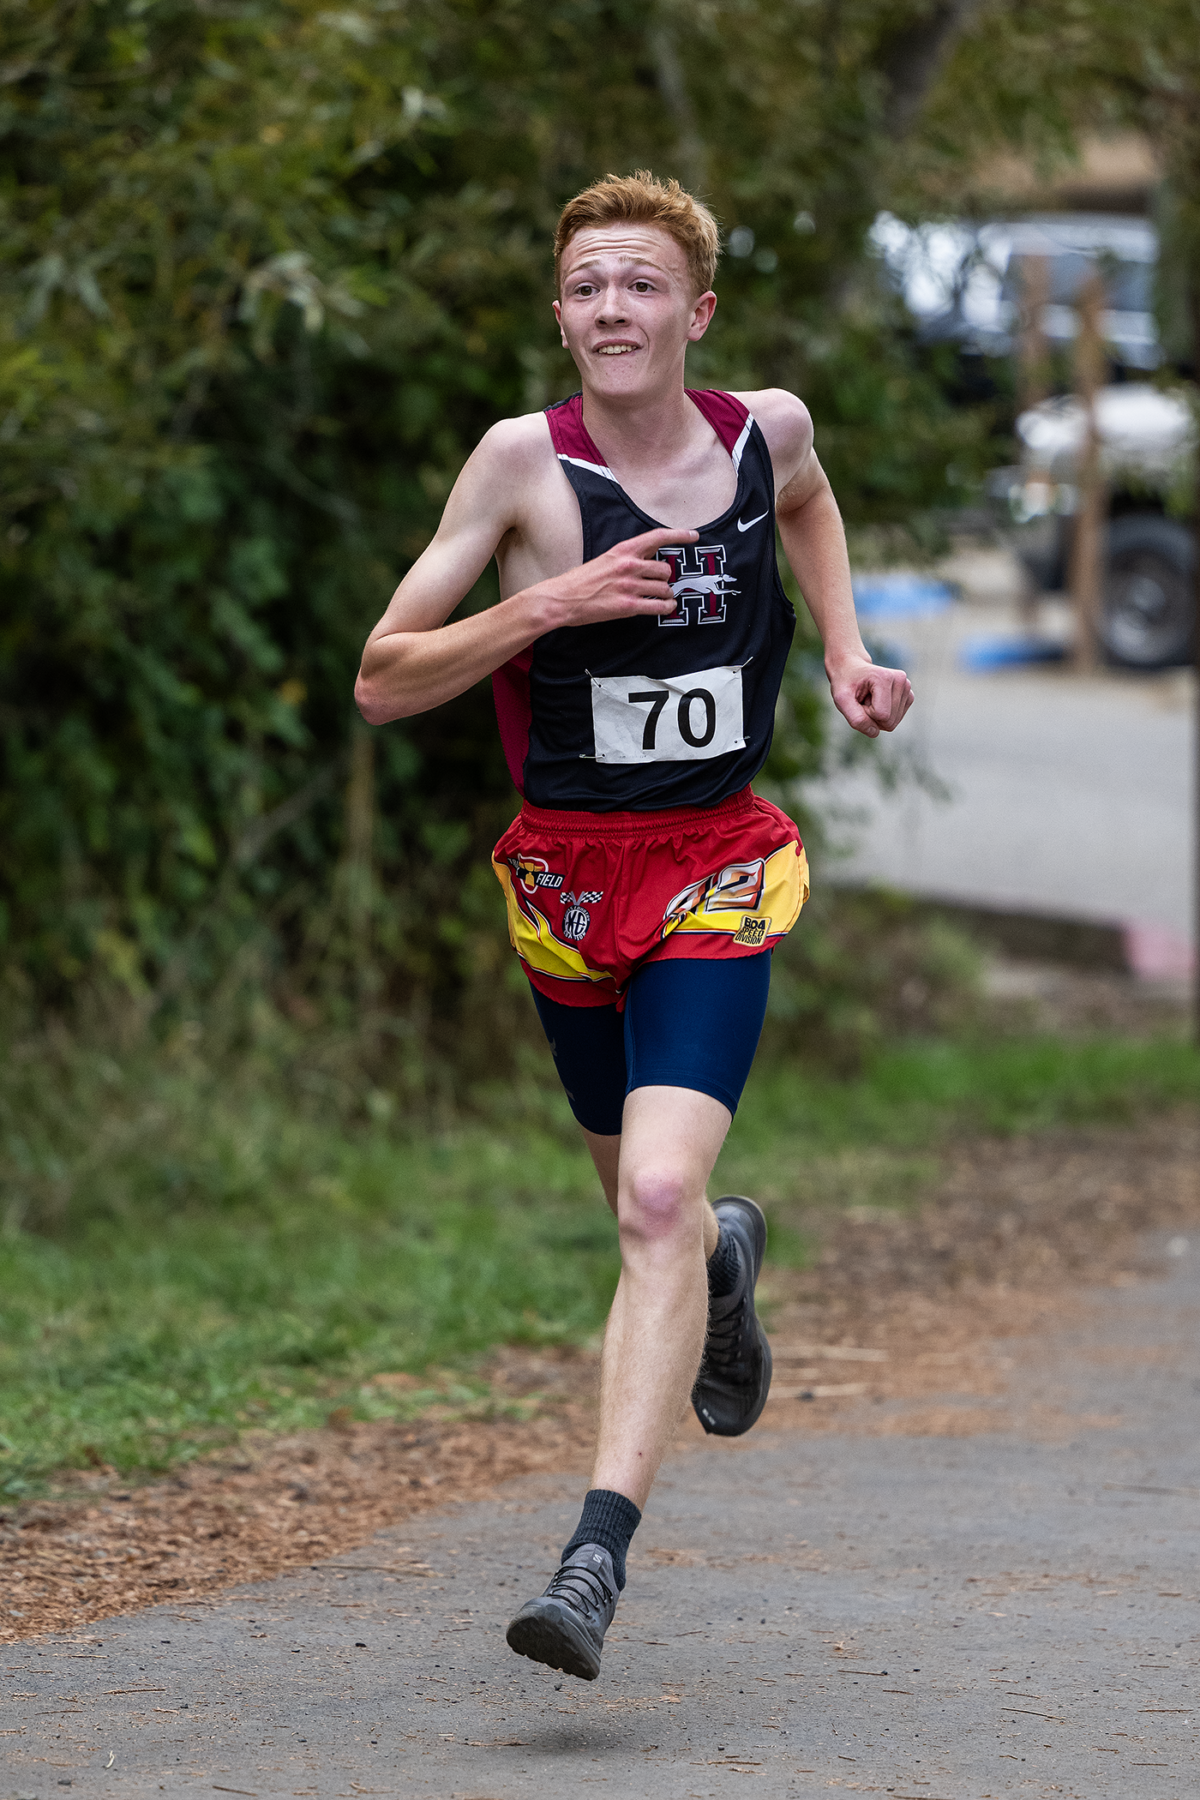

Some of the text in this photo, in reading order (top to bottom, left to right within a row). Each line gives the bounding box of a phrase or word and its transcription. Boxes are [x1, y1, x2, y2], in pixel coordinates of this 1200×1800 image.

[656, 544, 727, 627] H
[628, 687, 716, 750] 70
[536, 873, 563, 888] FIELD
[744, 917, 766, 930] BOA
[735, 932, 763, 945] DIVISION
[740, 926, 765, 937] SPEED
